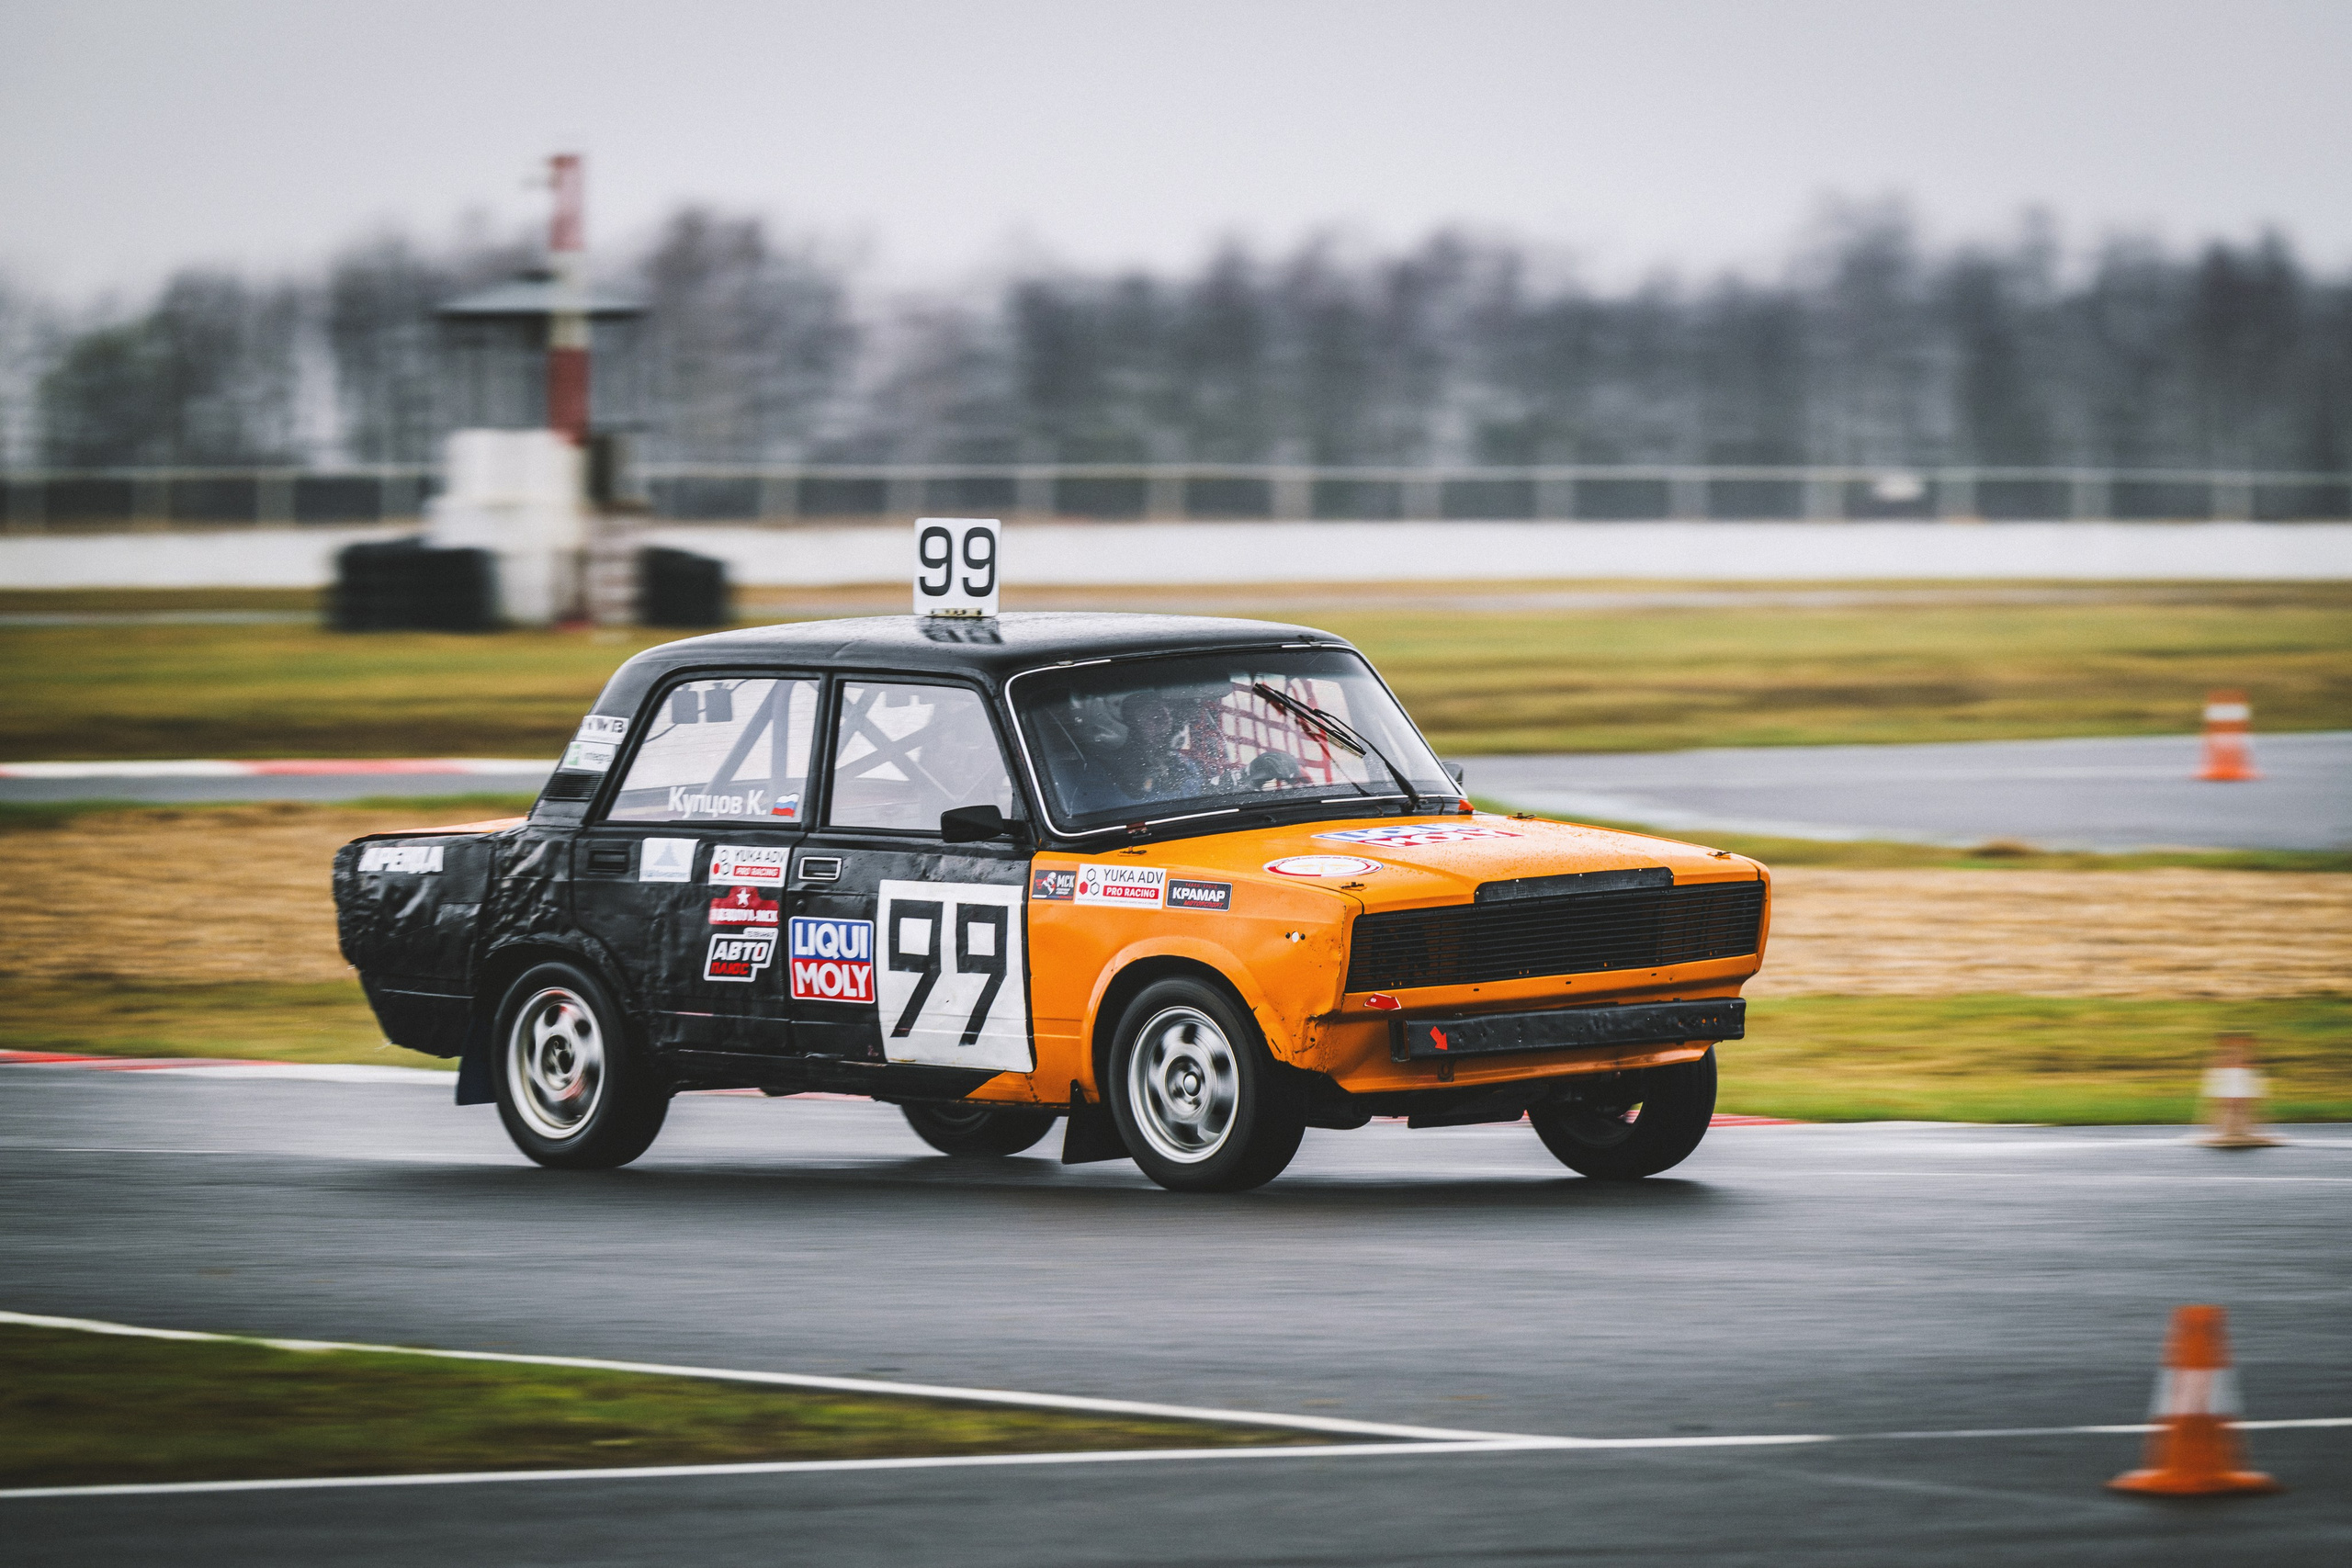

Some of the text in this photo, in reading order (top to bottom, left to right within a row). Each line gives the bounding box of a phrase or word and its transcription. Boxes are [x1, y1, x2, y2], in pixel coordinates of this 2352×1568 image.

[920, 525, 996, 597] 99
[667, 786, 767, 818] Купцов К.
[735, 866, 779, 877] PRO RACING
[1103, 868, 1163, 885] YUKA ADV
[1105, 886, 1156, 899] PRO RACING
[1171, 886, 1226, 902] КРАМАР
[794, 921, 869, 960] LIQUI
[712, 941, 769, 962] АВТО
[710, 962, 750, 975] ПЛЮС
[888, 898, 1009, 1047] 99
[794, 961, 872, 998] MOLY
